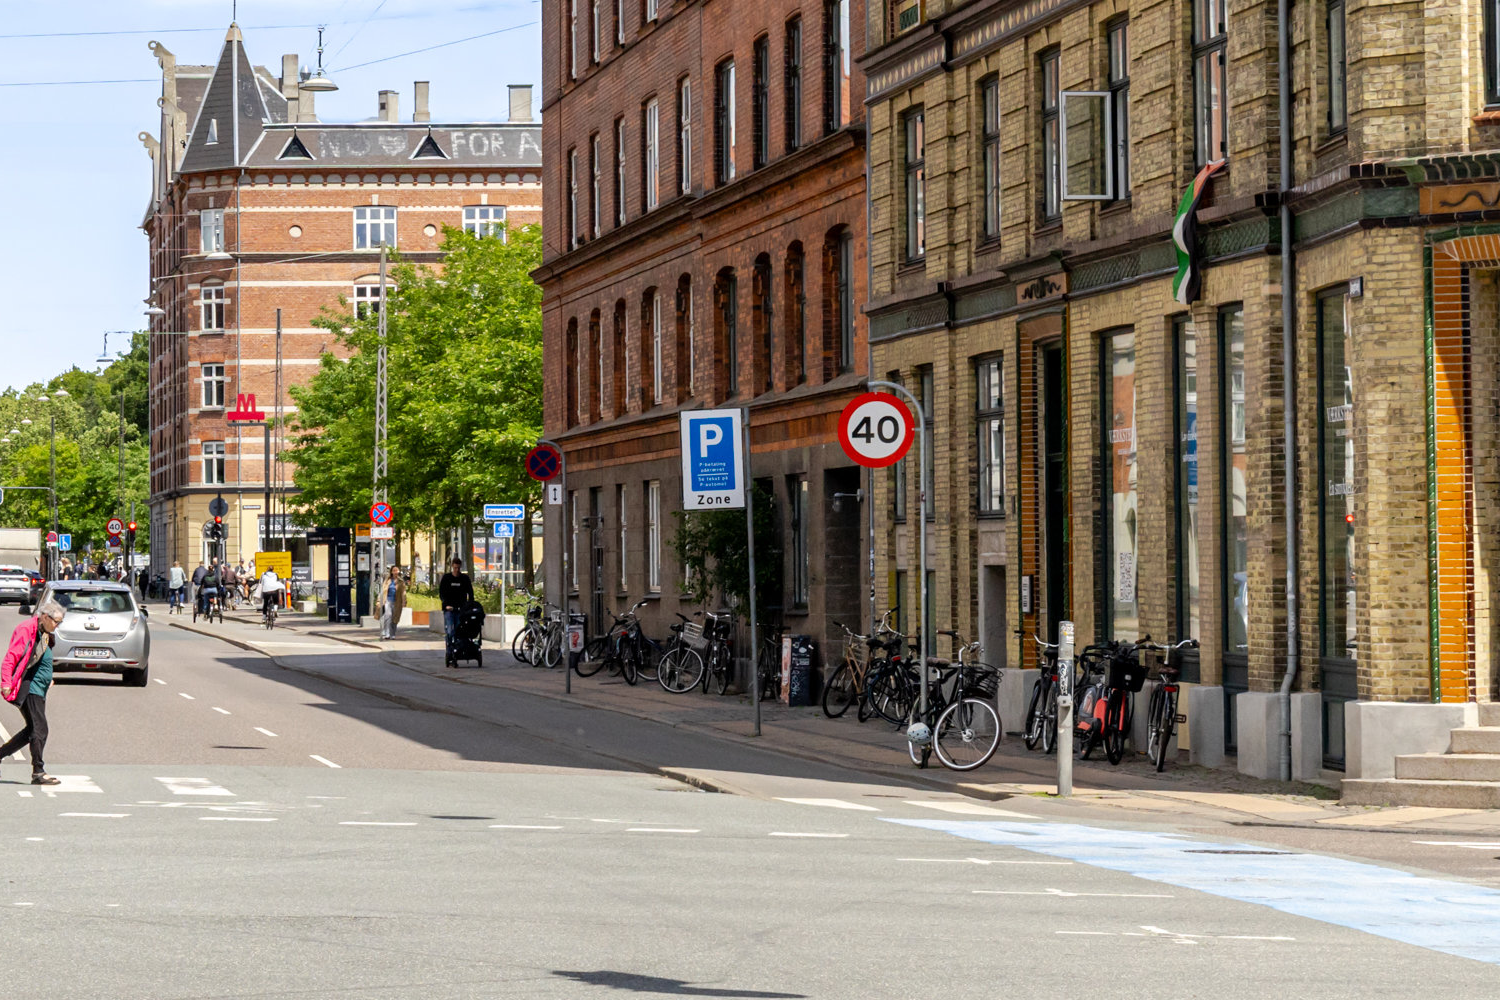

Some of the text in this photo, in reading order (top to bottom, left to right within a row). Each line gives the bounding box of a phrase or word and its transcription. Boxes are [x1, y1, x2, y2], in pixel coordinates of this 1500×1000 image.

[450, 131, 506, 158] FOR
[699, 423, 723, 458] P
[850, 415, 900, 444] 40
[697, 494, 731, 505] Zone
[109, 523, 120, 531] 40
